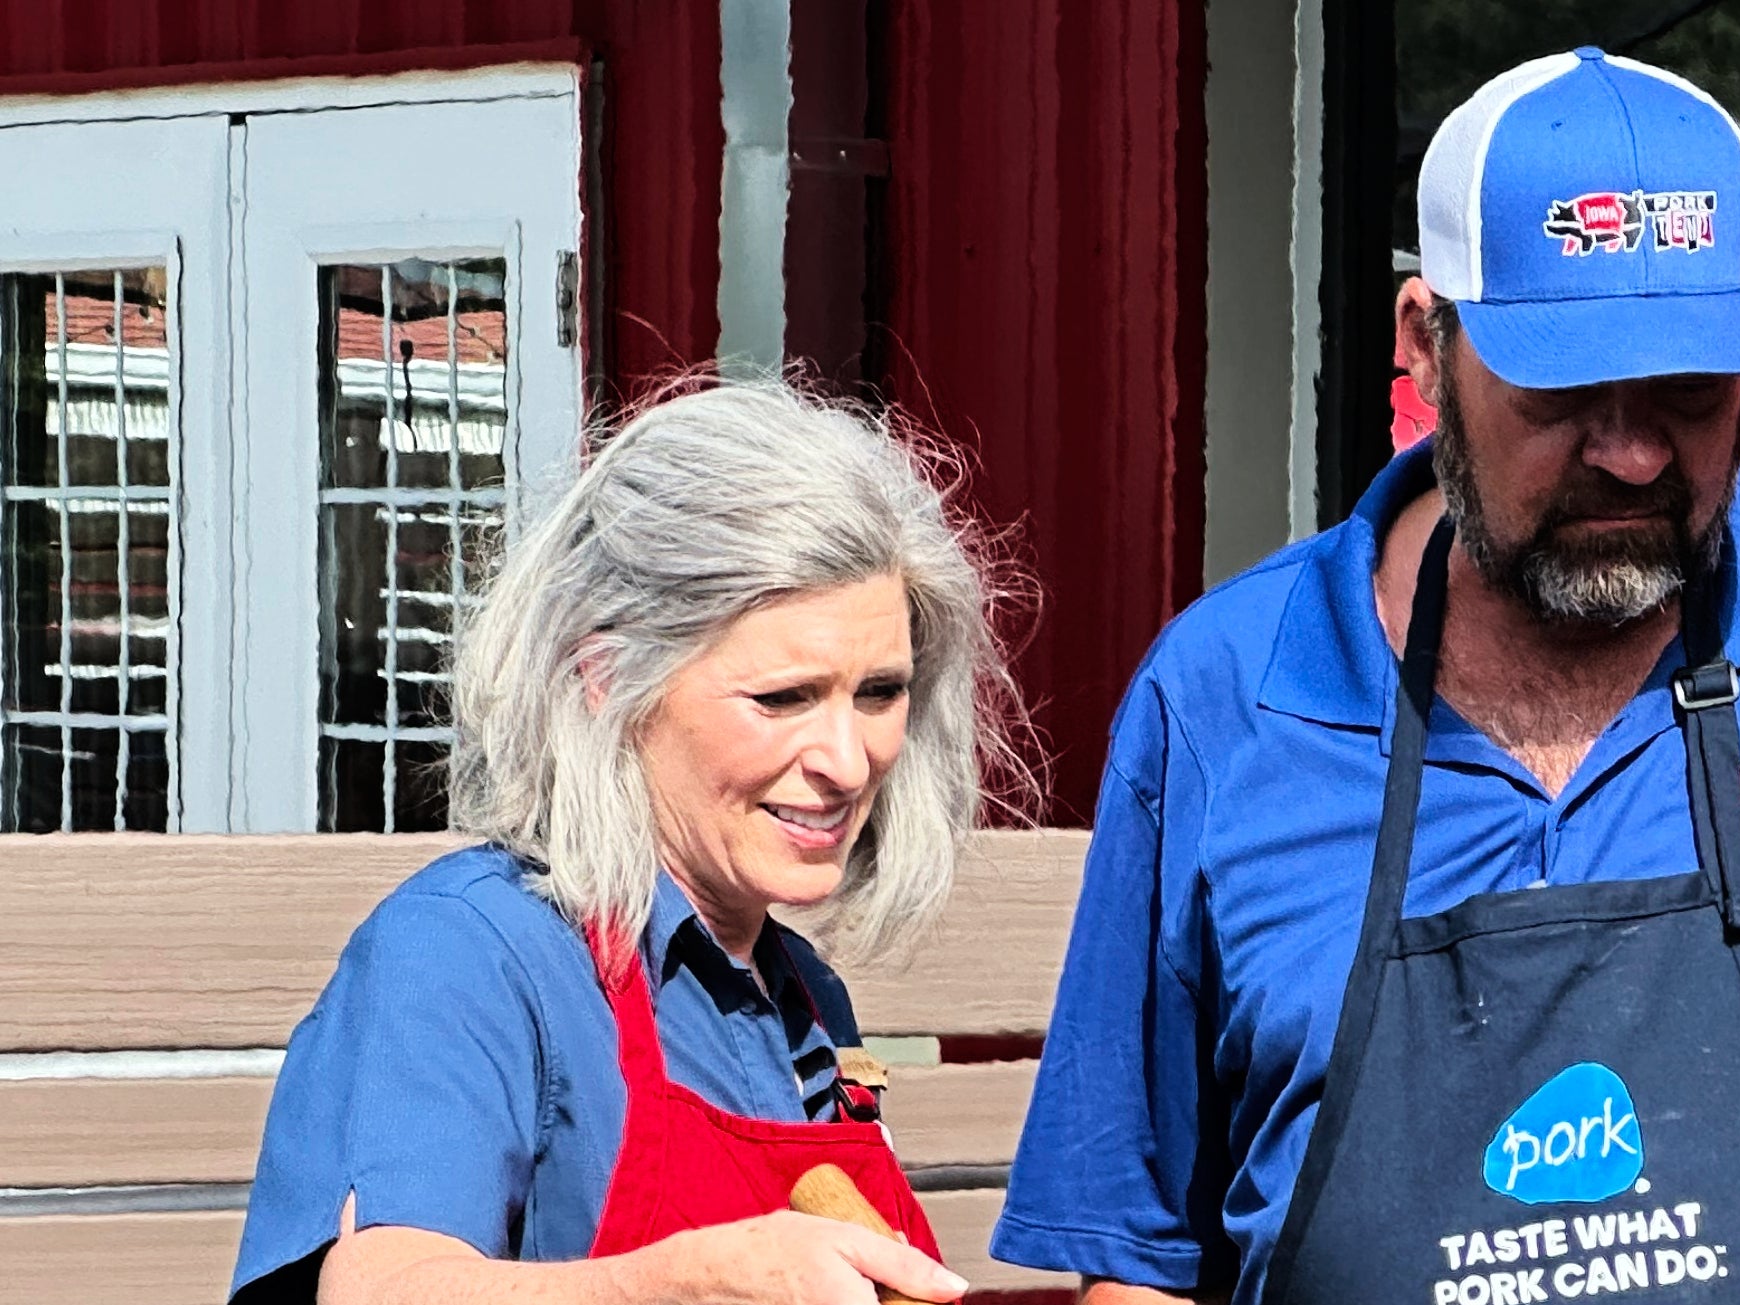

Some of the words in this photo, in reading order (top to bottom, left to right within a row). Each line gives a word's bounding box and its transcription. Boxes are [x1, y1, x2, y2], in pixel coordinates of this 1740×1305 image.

[1585, 205, 1619, 225] IOWA
[1653, 196, 1707, 211] PORK
[1502, 1097, 1638, 1190] pork
[1440, 1219, 1569, 1271] TASTE
[1574, 1202, 1701, 1250] WHAT
[1553, 1252, 1650, 1298] CAN
